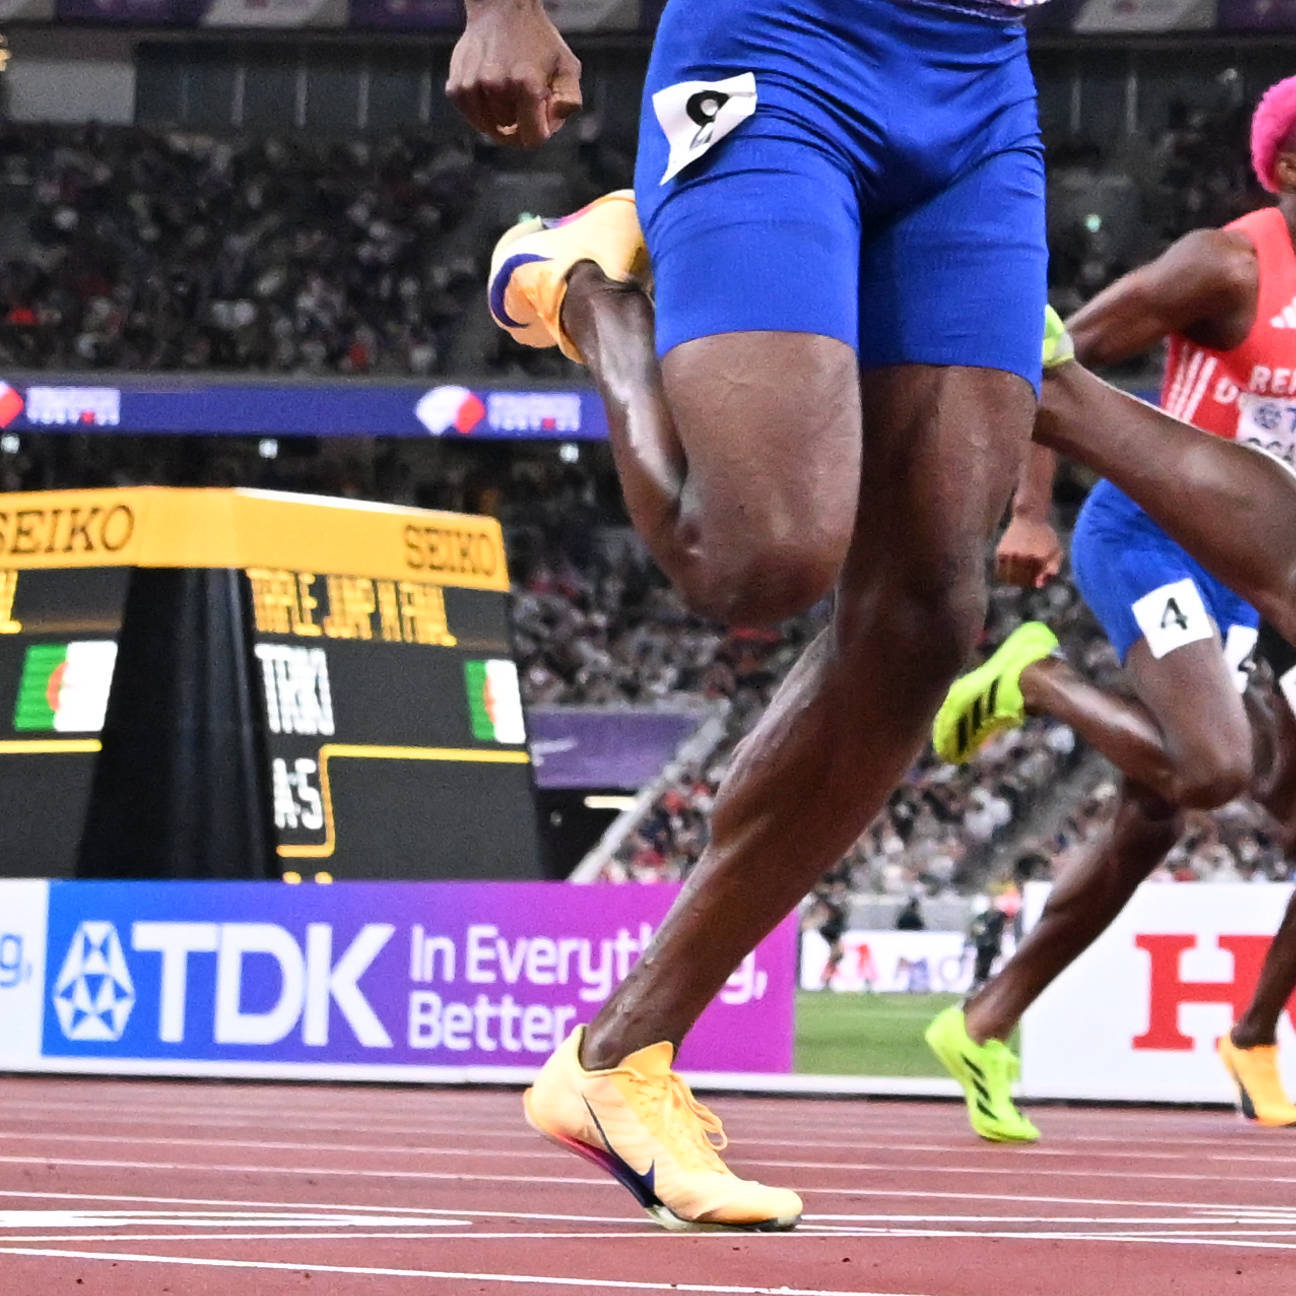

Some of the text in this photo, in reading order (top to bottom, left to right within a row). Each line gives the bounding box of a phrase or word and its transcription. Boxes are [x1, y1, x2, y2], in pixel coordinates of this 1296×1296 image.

[403, 523, 497, 577] SEIKO
[1161, 597, 1188, 630] 4
[410, 924, 456, 983] In
[131, 922, 397, 1049] TDK
[408, 990, 577, 1052] Better
